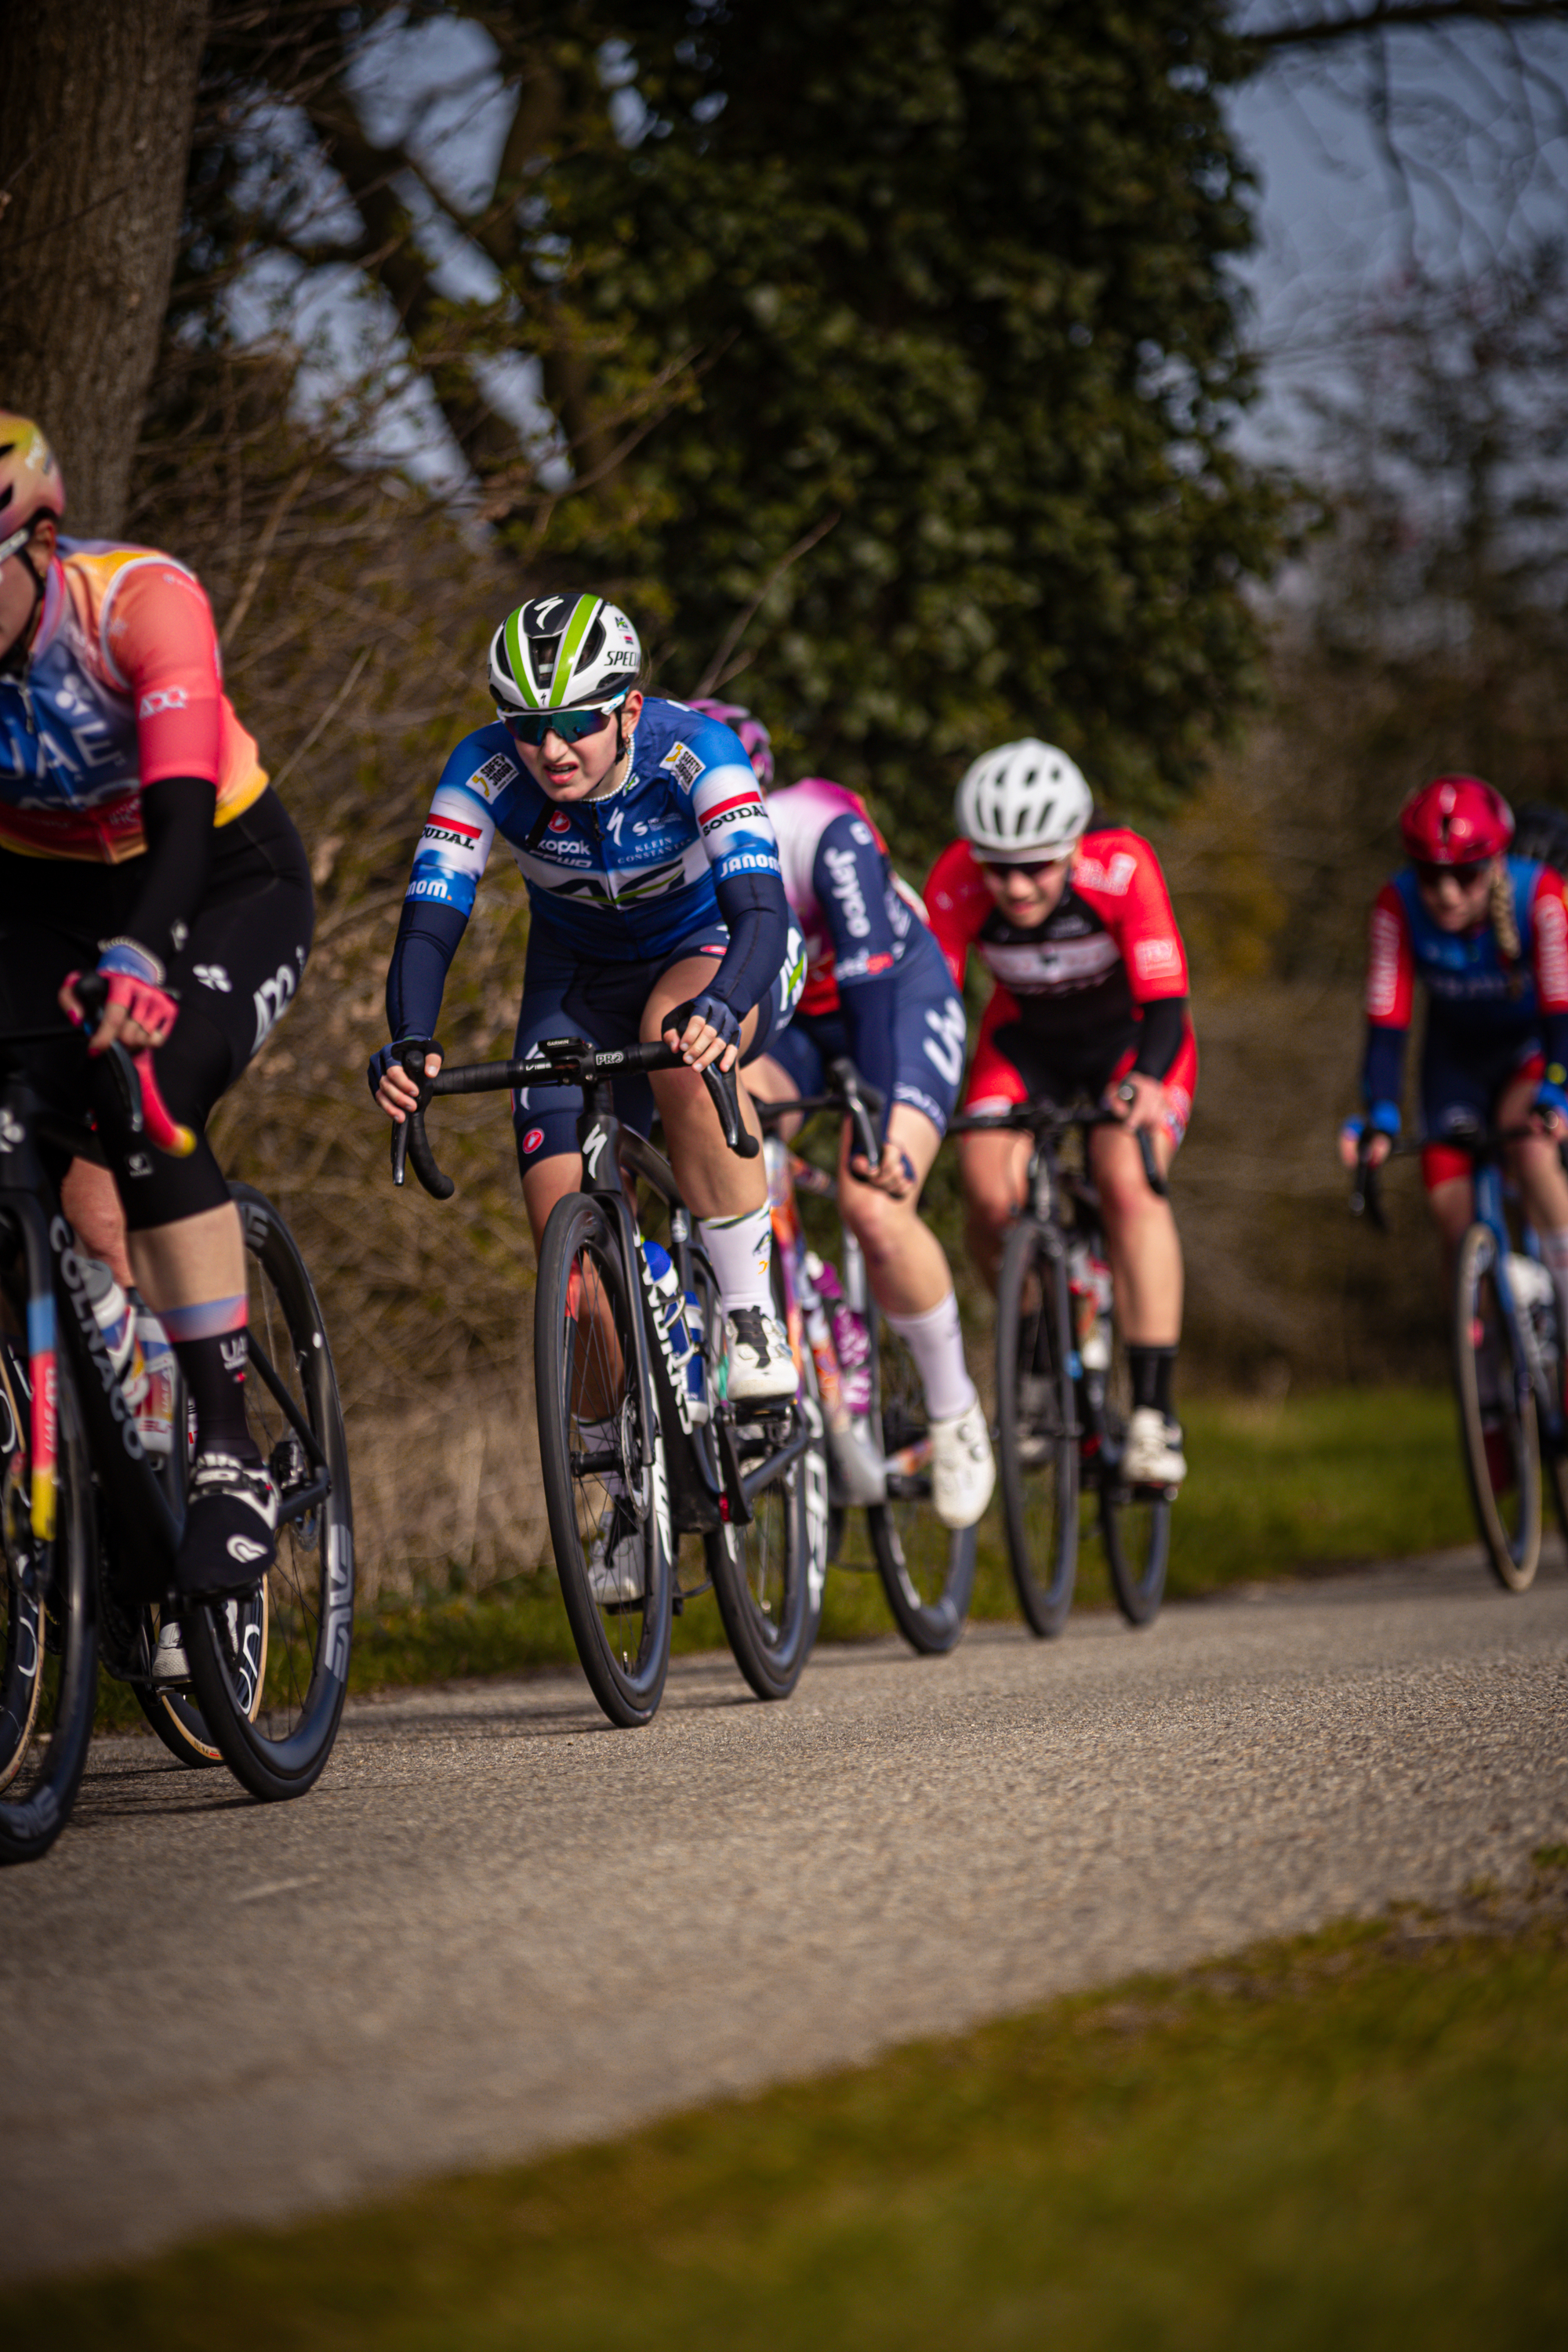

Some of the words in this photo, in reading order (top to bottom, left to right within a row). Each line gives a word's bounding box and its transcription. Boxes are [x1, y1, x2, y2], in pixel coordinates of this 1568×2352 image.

[702, 805, 768, 837] SOUDAL
[422, 826, 475, 851] UDAL
[49, 1215, 144, 1461] COLNAGO
